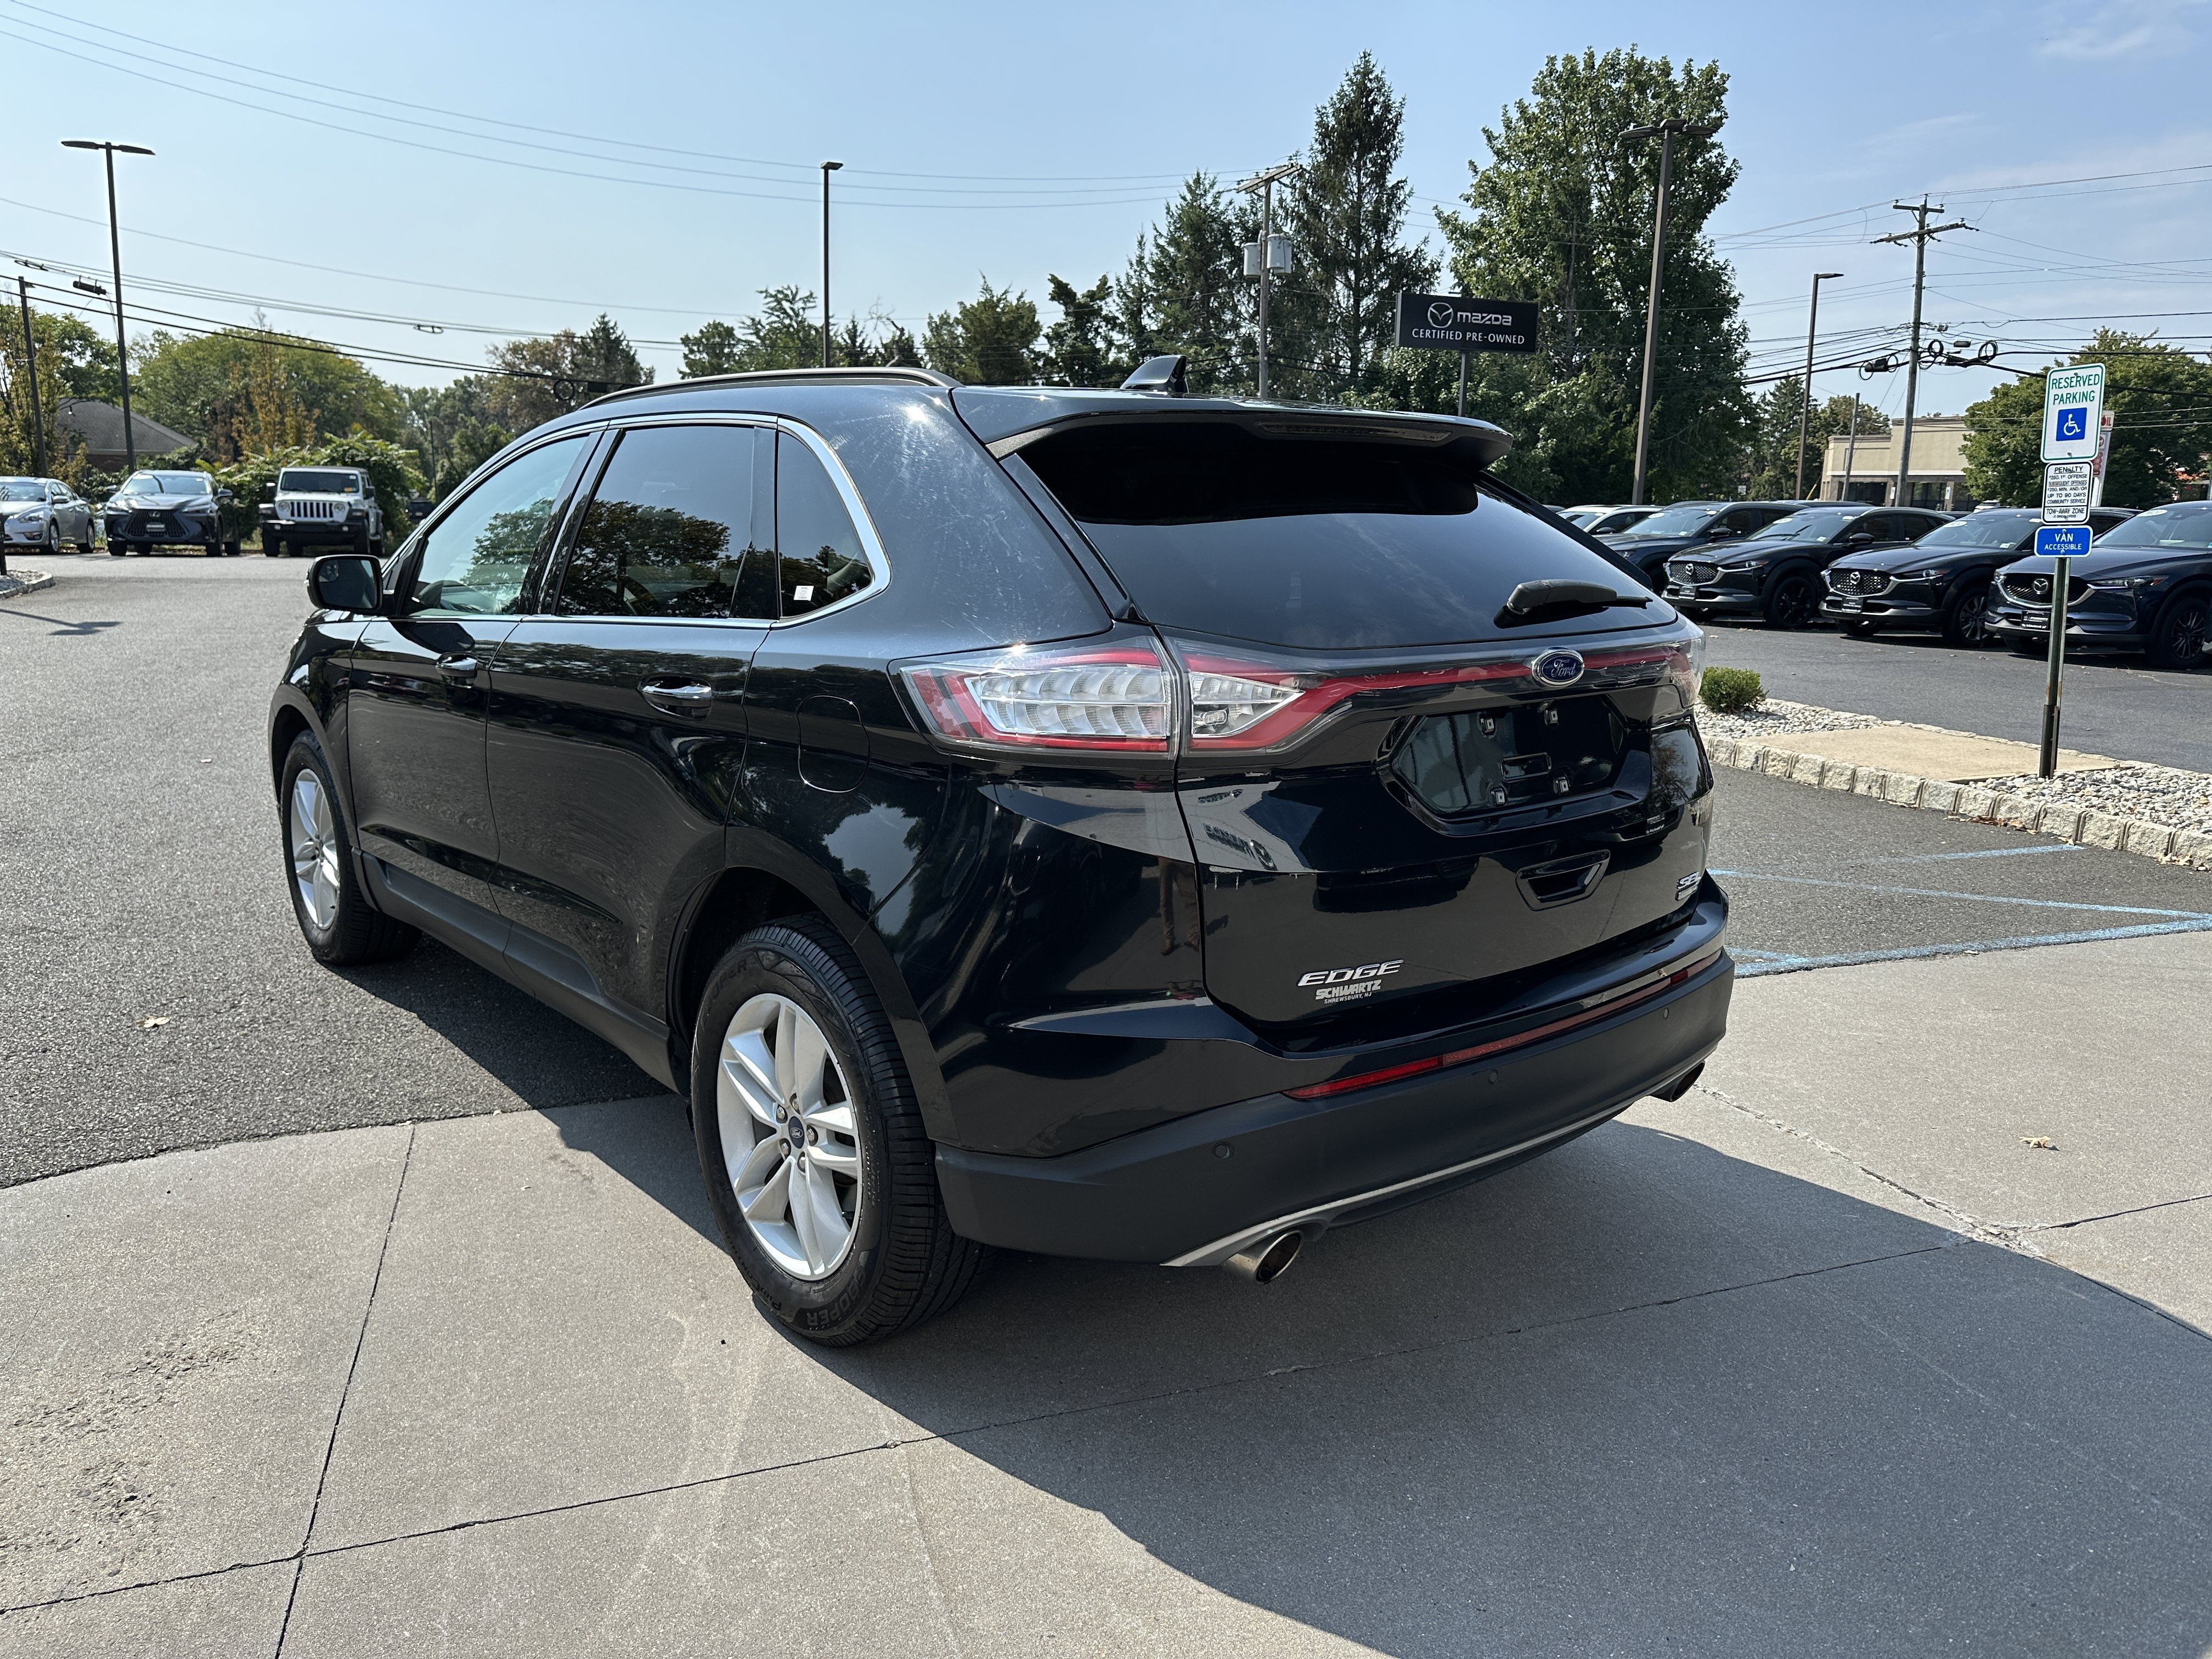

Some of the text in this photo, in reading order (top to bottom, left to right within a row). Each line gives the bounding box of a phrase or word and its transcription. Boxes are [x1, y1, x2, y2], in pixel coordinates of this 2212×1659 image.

[1412, 328, 1525, 345] CERTIFIED PRE-OWNED
[2051, 374, 2100, 390] RESERVED
[2052, 390, 2096, 405] PARKING
[2055, 533, 2073, 542] VAN
[1551, 659, 1576, 678] Ford
[1297, 959, 1404, 986] EDGE
[1315, 979, 1382, 1000] SCHWARTZ
[1324, 993, 1363, 1004] SHREWSBURY,
